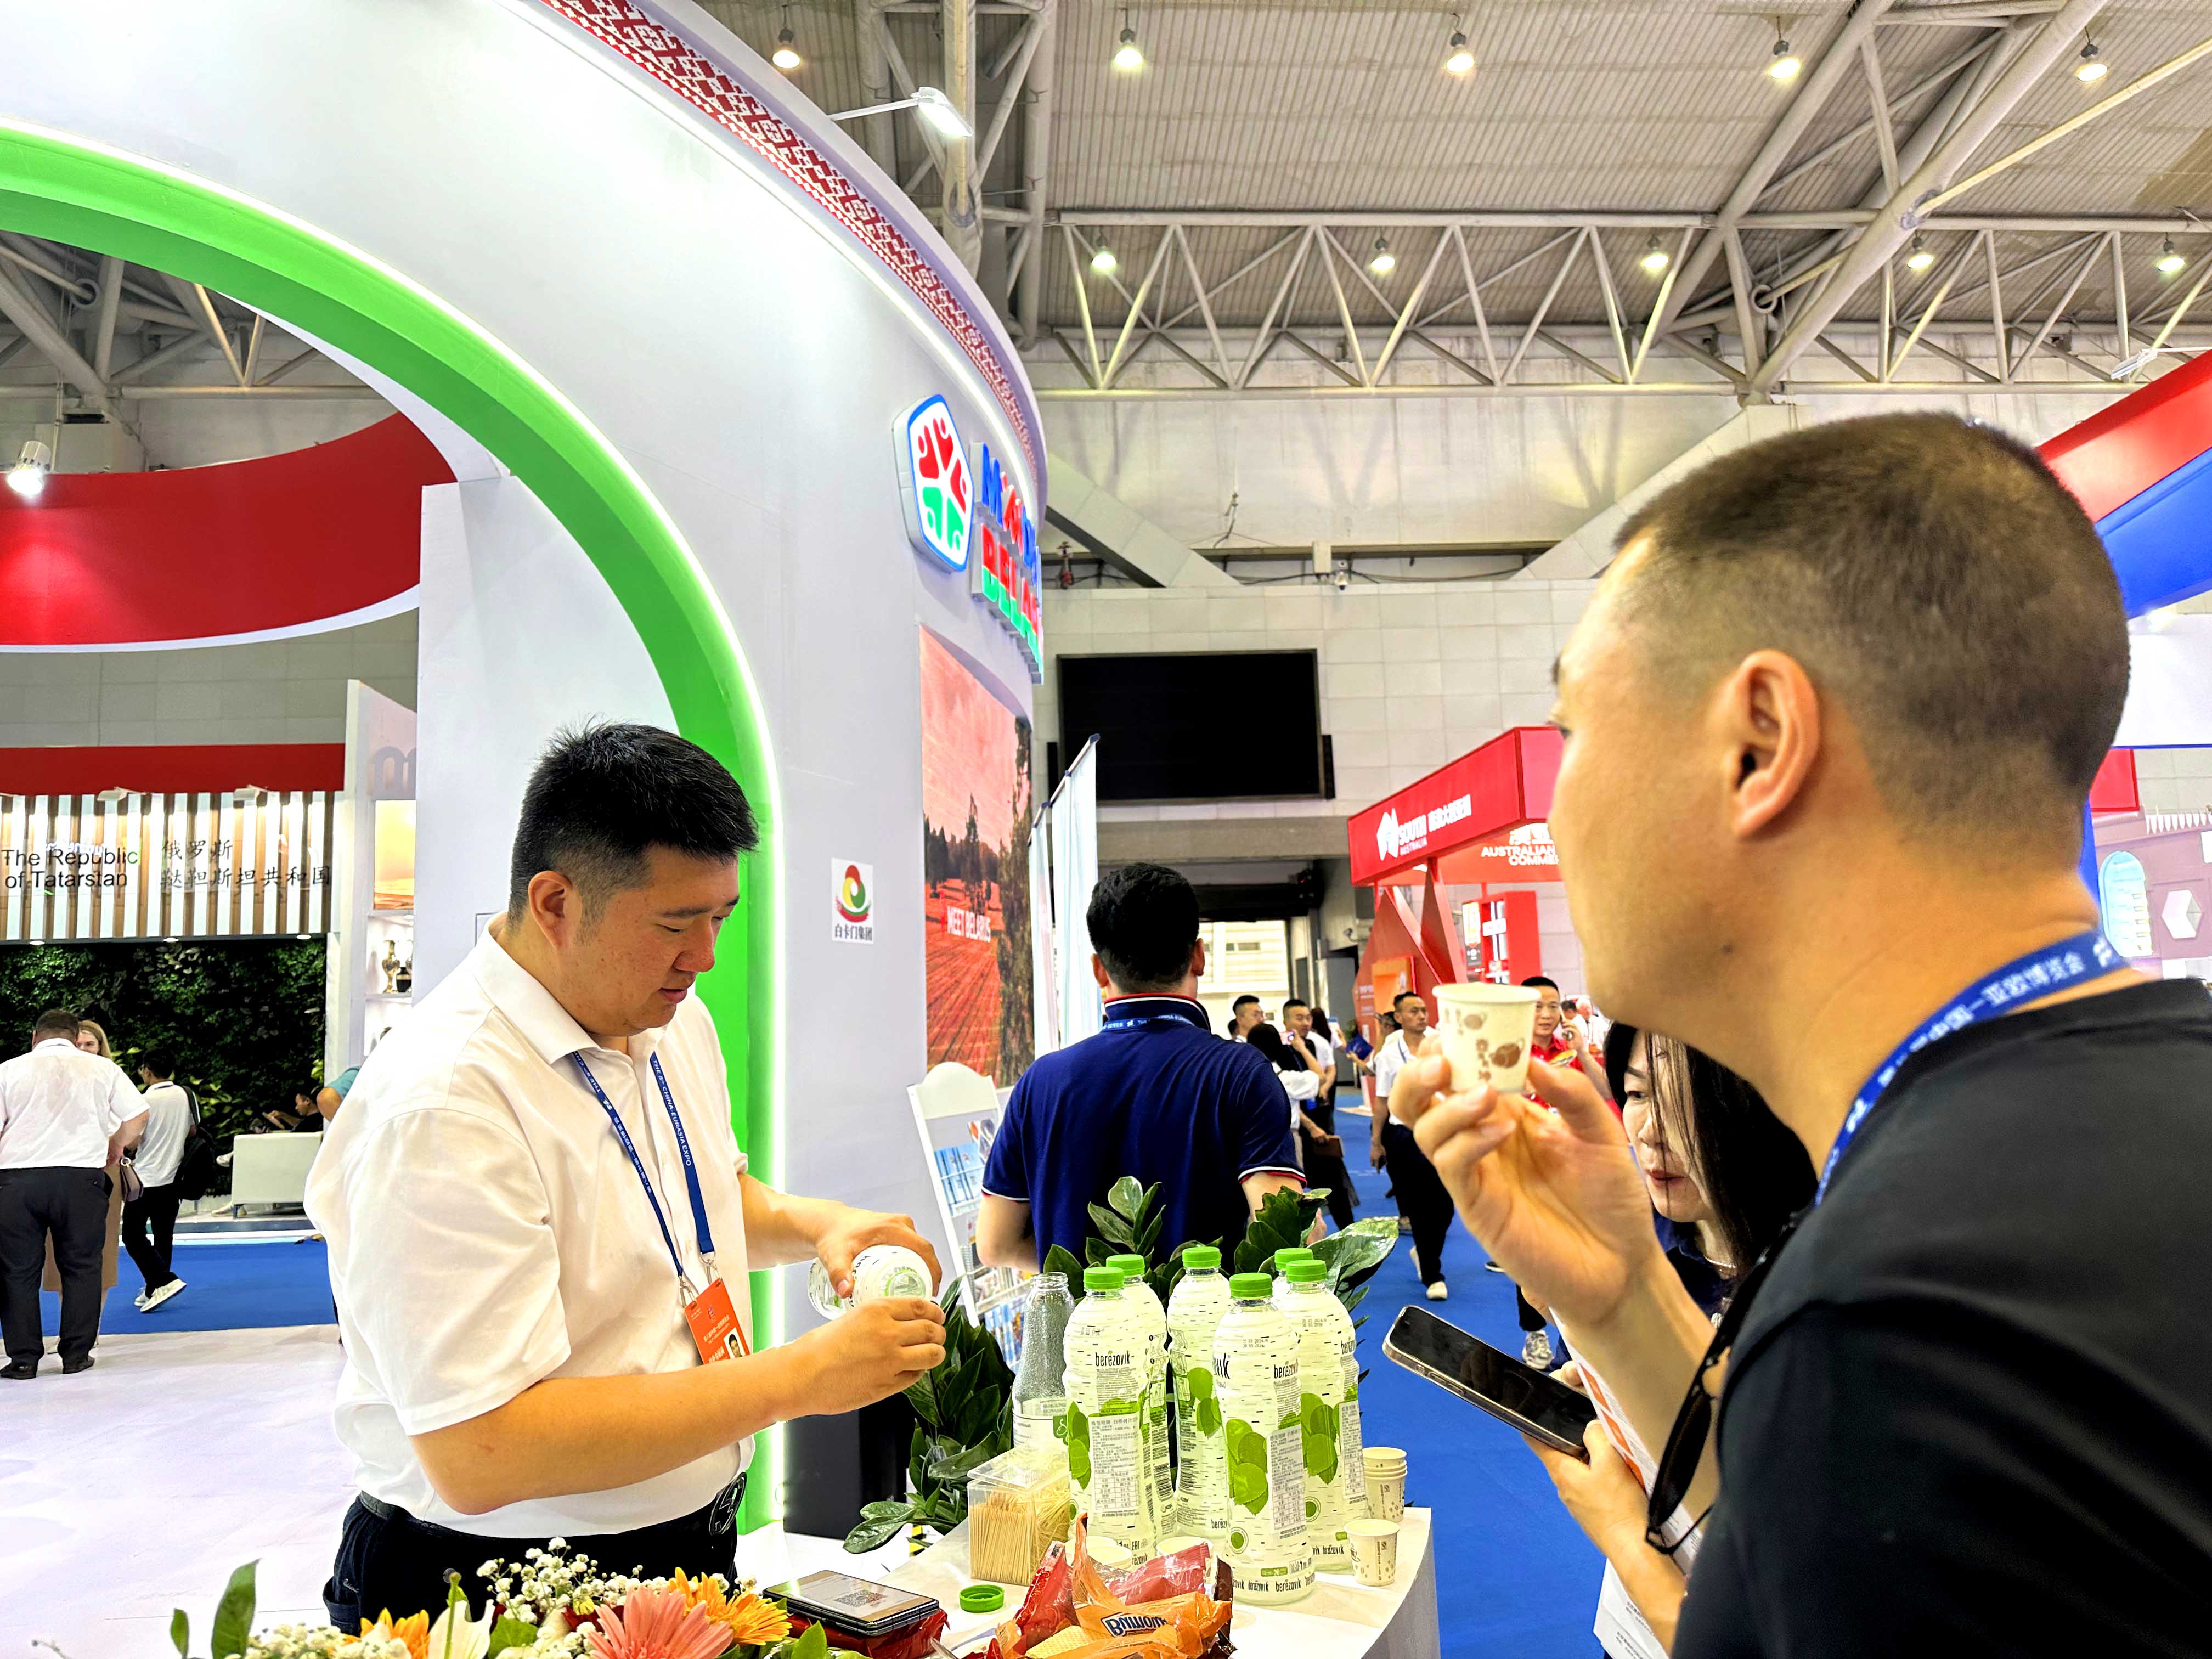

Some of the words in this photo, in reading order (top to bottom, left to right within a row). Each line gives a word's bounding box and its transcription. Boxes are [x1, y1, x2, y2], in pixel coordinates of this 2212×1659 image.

[981, 522, 1044, 685] BELAR
[1399, 814, 1427, 845] SOUTH
[2, 849, 40, 866] The
[48, 848, 138, 868] Republic
[161, 839, 233, 860] 俄罗斯
[1481, 845, 1555, 857] AUSTRALIAN
[5, 871, 26, 888] of
[32, 871, 127, 887] Tatarstan
[947, 906, 964, 938] MEET
[964, 911, 991, 943] BELARUS
[653, 1060, 662, 1074] THE
[682, 1145, 691, 1166] EXPO
